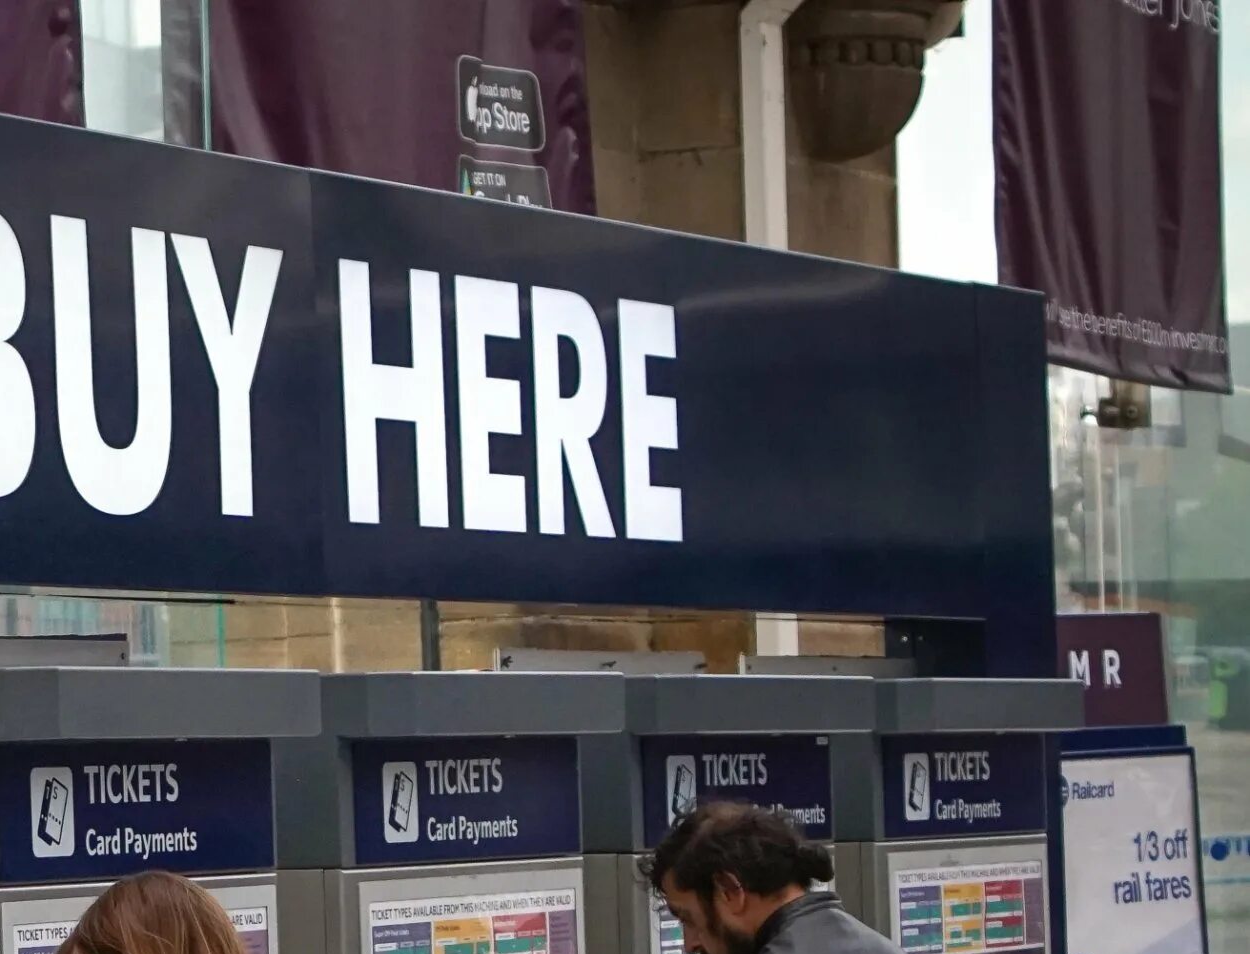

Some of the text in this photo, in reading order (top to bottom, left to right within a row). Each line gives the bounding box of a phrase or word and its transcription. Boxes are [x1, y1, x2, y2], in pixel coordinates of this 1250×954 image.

[493, 101, 530, 133] Store
[338, 258, 684, 543] HERE
[425, 757, 503, 795] TICKETS
[702, 753, 768, 787] TICKETS
[934, 751, 990, 781] TICKETS
[84, 763, 180, 804] TICKETS
[1072, 780, 1115, 800] Railcard
[936, 799, 1001, 823] Card Payments
[85, 827, 198, 860] Card Payments
[427, 815, 518, 844] Card Payments
[1163, 829, 1188, 861] off
[1113, 870, 1193, 904] rail fares
[244, 912, 263, 925] VALID
[371, 908, 393, 920] TICKET
[393, 907, 412, 919] TYPES
[413, 904, 443, 918] AVAILABLE
[443, 903, 460, 915] FROM
[460, 902, 474, 914] THIS
[17, 927, 68, 942] TICKET TYPES
